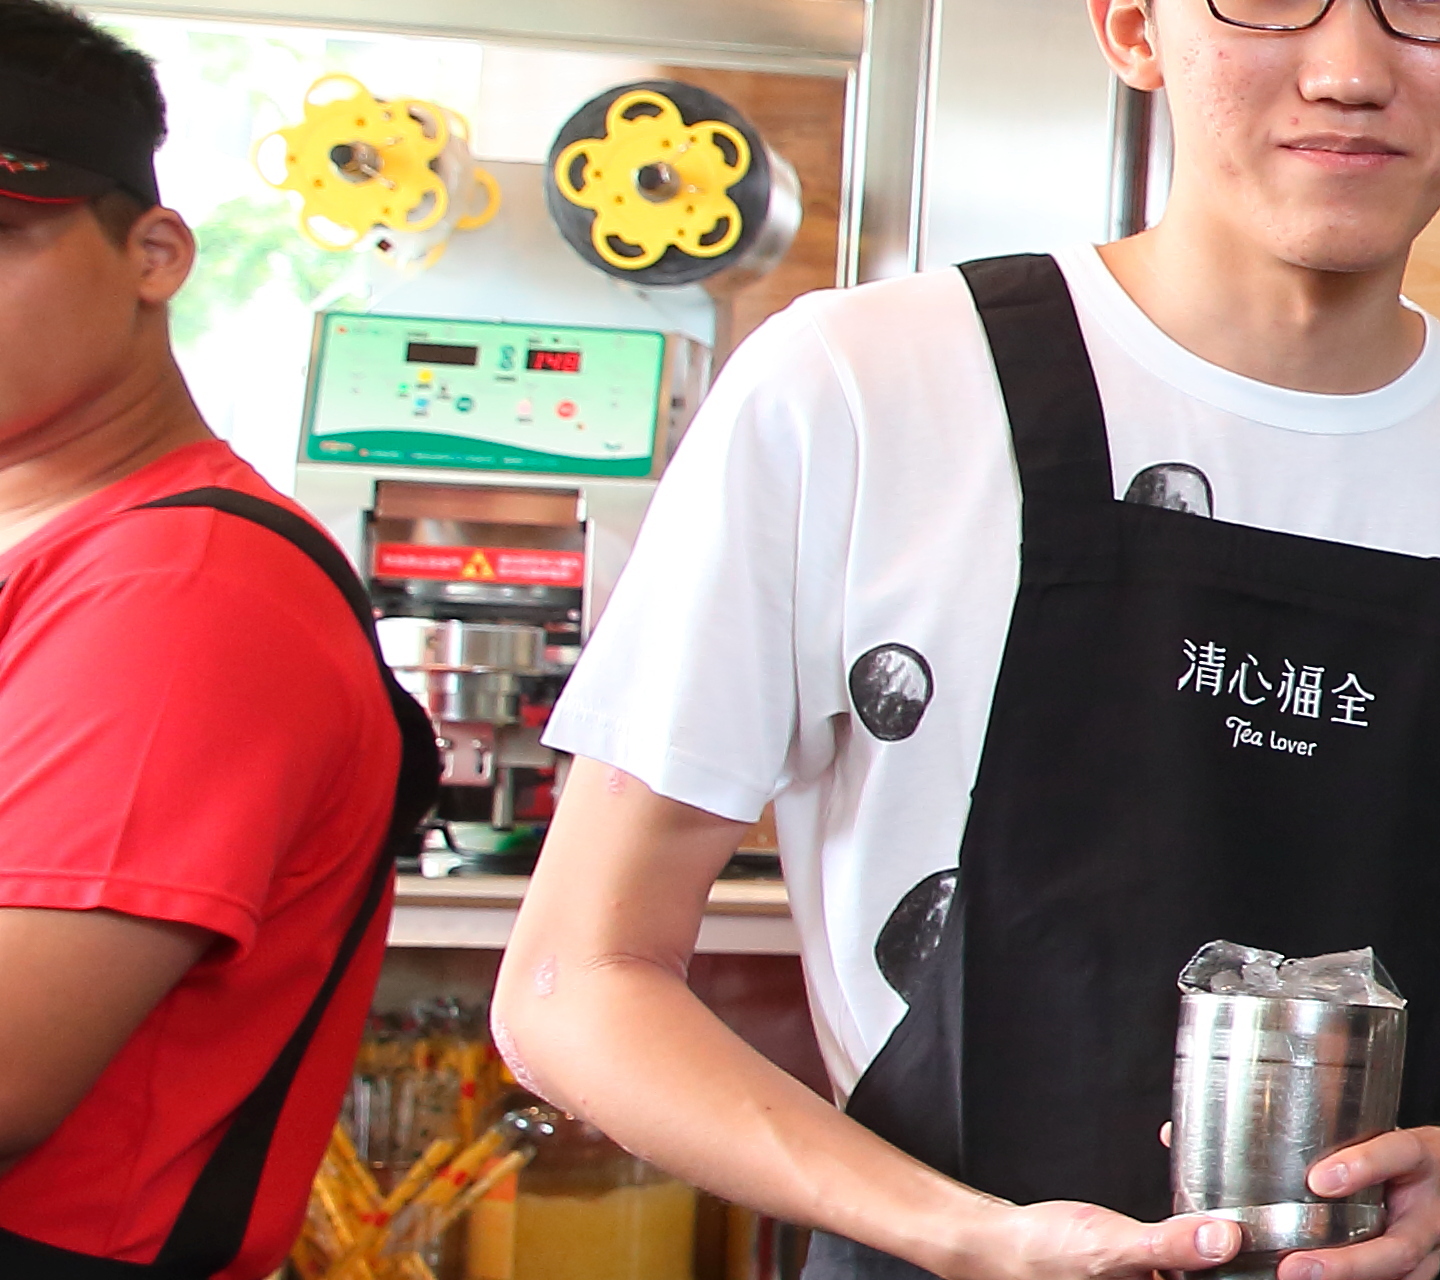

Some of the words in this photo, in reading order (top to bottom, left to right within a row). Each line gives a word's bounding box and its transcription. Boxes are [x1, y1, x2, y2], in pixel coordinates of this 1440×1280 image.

[1176, 638, 1376, 727] 清心福全
[1225, 716, 1263, 748] Tea
